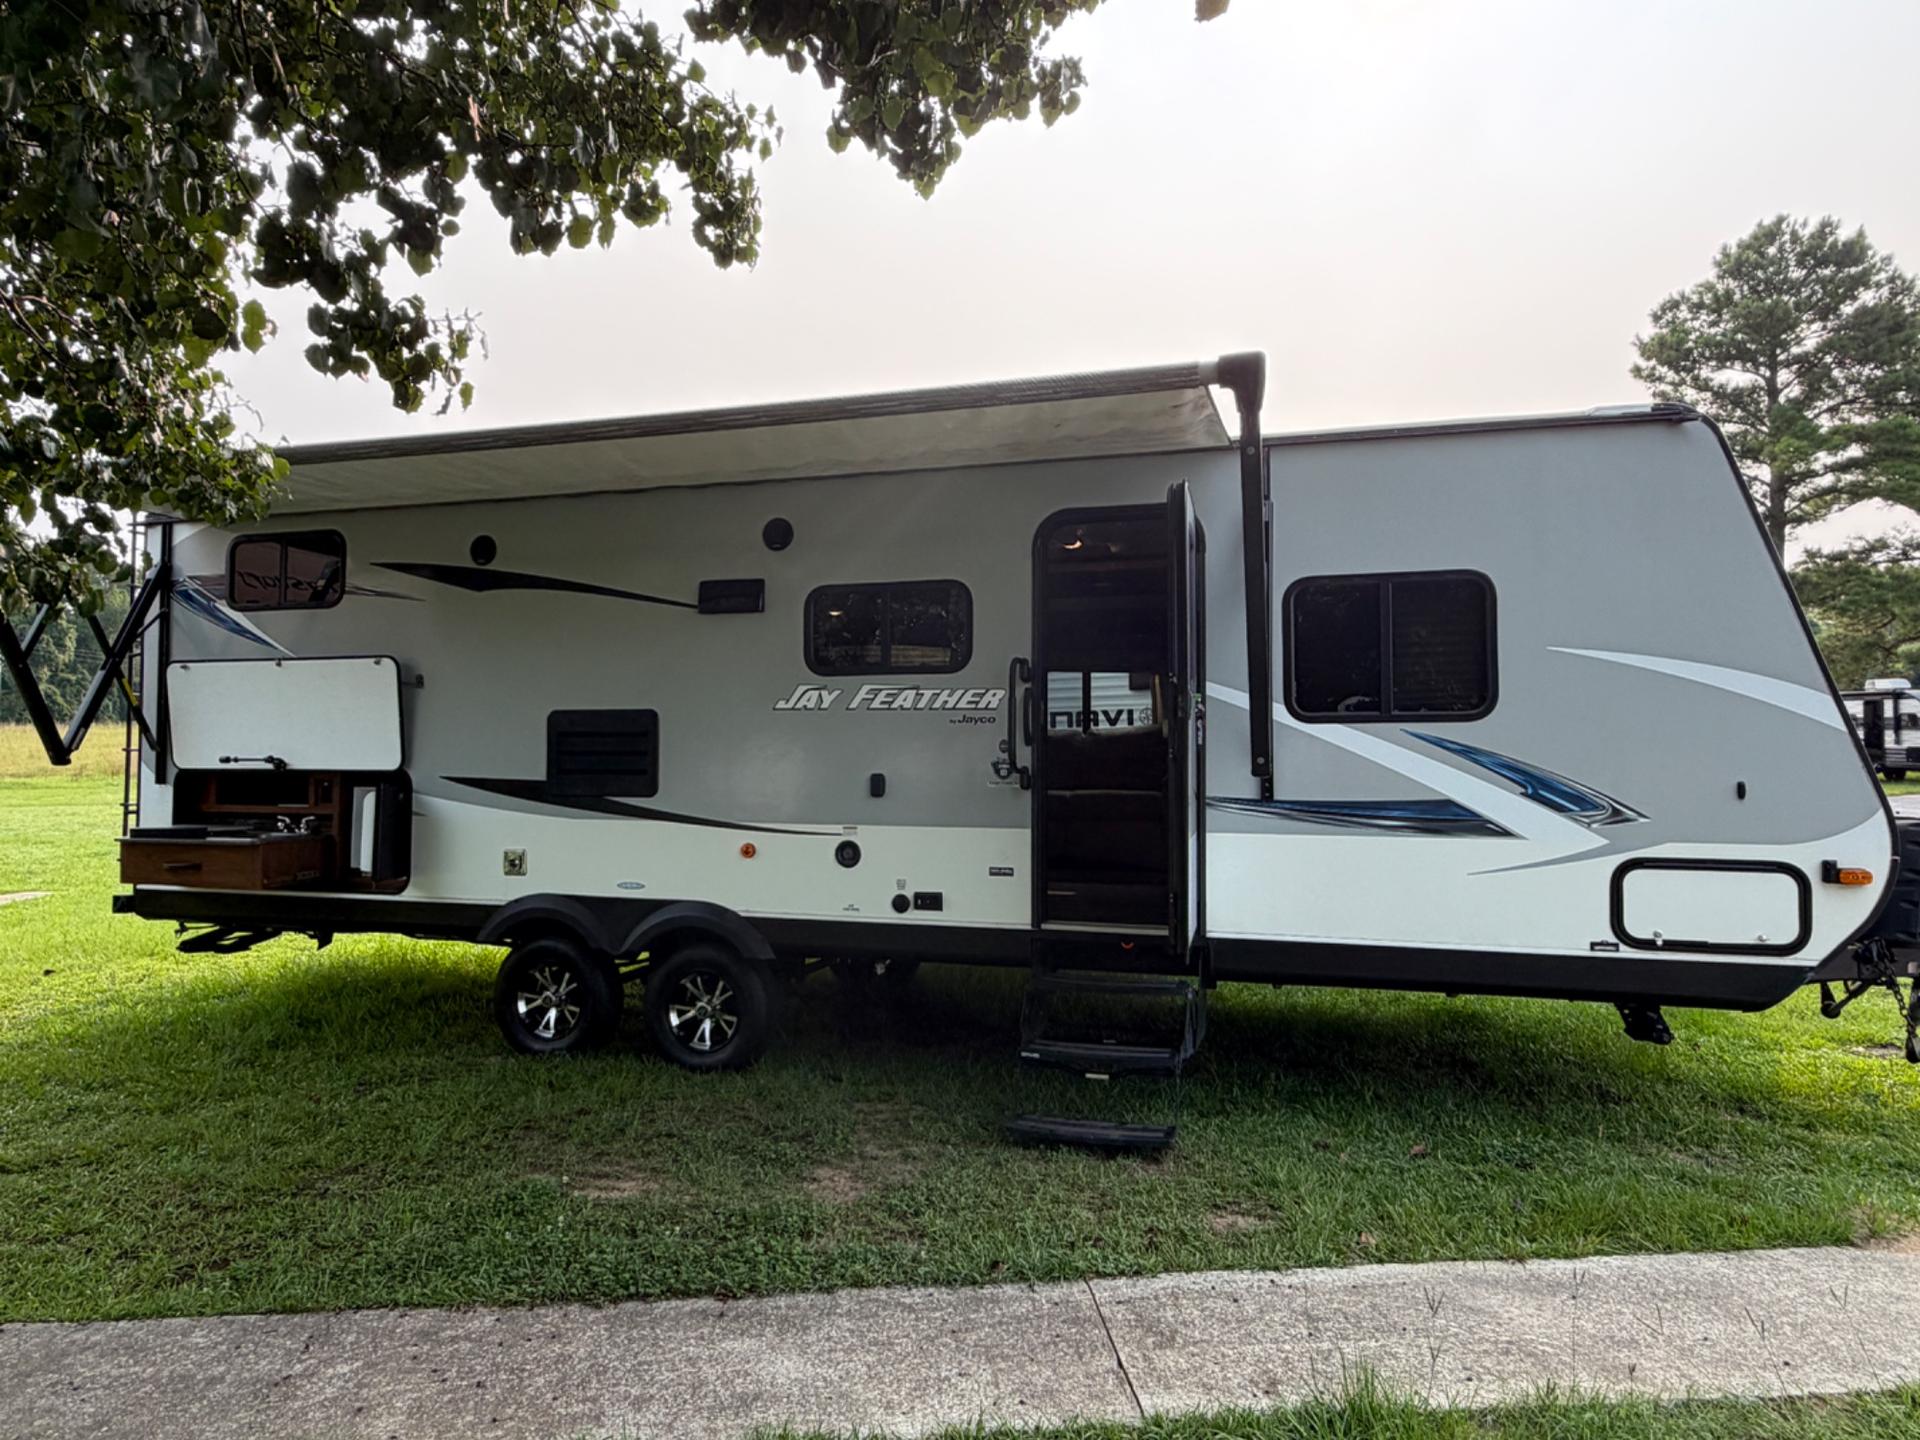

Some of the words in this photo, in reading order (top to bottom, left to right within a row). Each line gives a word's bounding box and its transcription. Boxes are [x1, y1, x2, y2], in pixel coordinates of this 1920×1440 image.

[773, 684, 841, 711] JAY
[847, 684, 1006, 711] FEATHER
[957, 714, 996, 725] Jayco
